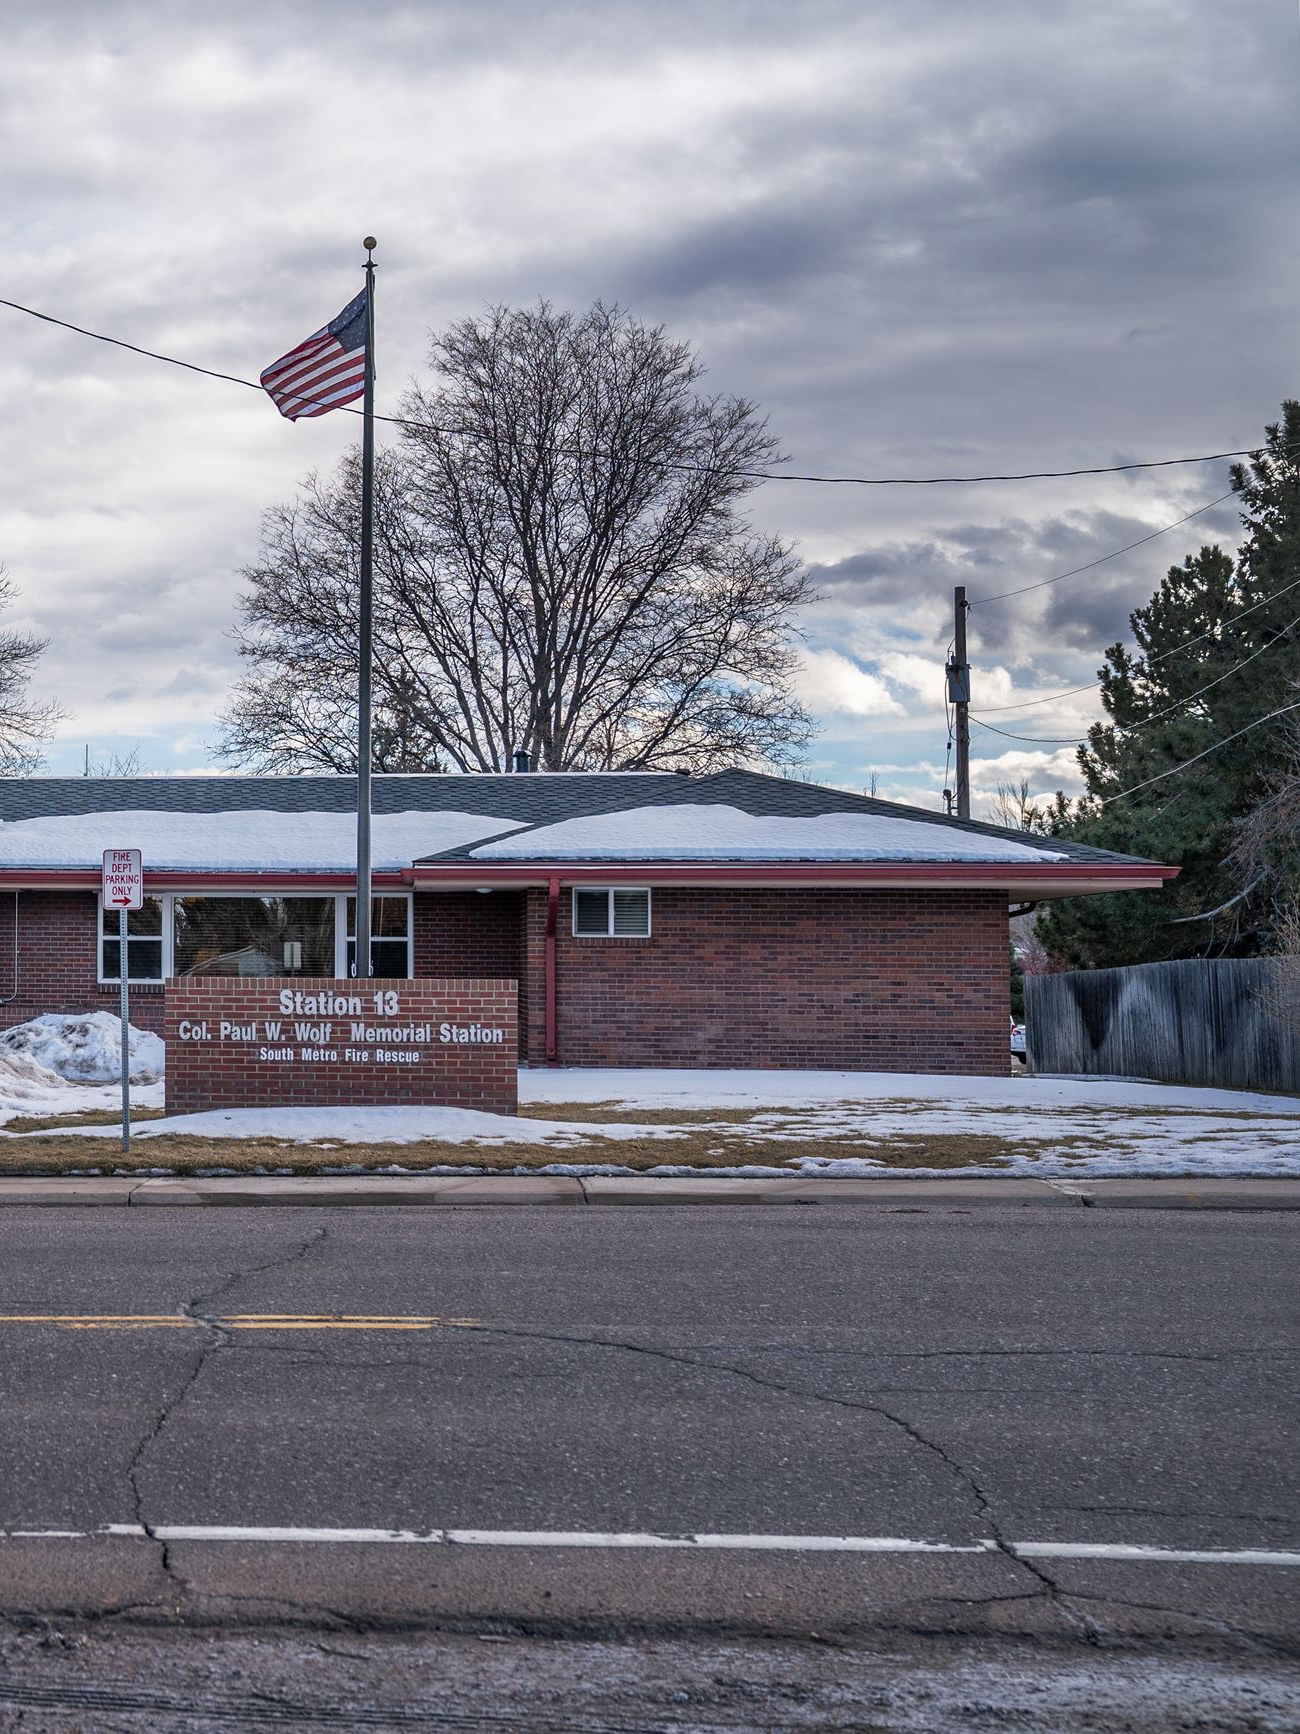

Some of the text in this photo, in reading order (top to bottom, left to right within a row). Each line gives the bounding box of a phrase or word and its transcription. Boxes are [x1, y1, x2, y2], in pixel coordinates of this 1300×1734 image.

[113, 852, 131, 861] FIRE
[112, 864, 132, 873] DEPT
[106, 875, 139, 884] PARKING
[112, 886, 132, 895] ONLY
[279, 989, 399, 1016] Station 13
[179, 1021, 503, 1043] Col. Paul W. Wolf Memorial Station
[260, 1047, 419, 1062] South Metro Fire Rescue
